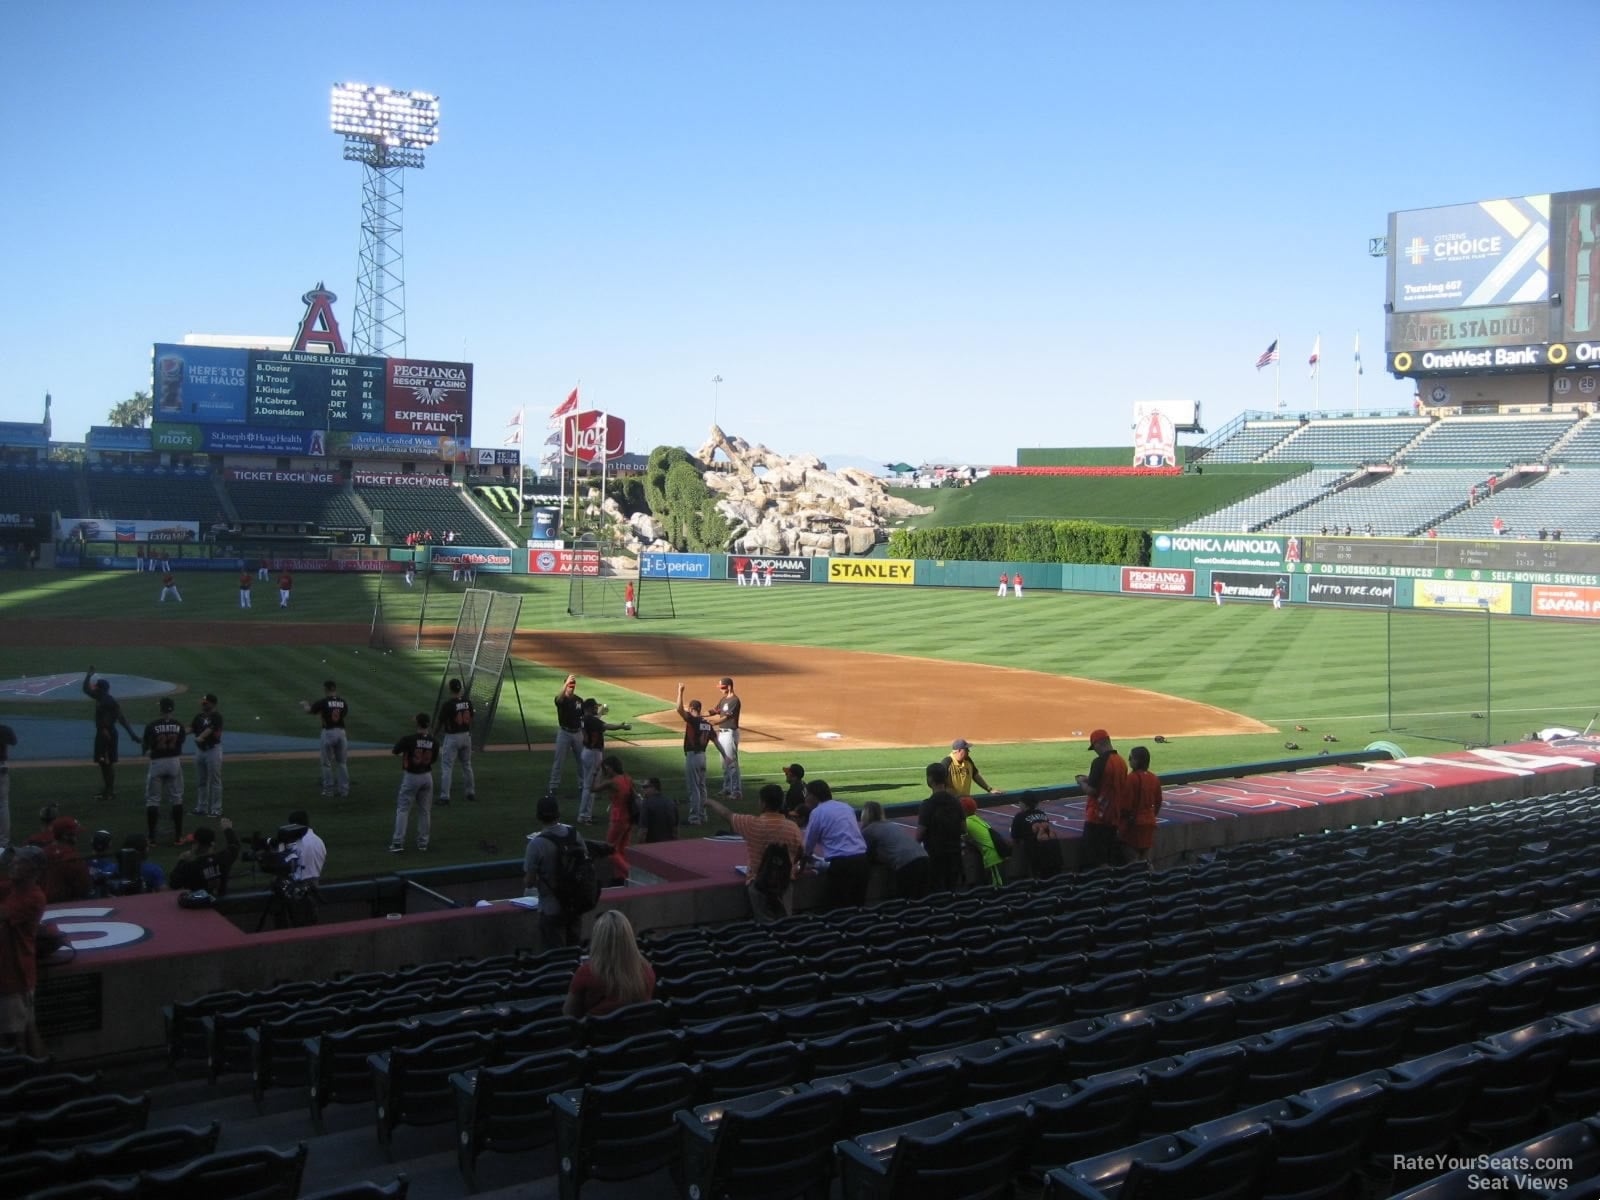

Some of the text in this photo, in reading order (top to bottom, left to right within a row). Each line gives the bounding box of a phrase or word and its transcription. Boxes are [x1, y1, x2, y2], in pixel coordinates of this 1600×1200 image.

[1434, 237, 1501, 257] CHOICE
[1404, 283, 1443, 294] Turning
[1405, 316, 1534, 341] ANGEL STADIUM
[295, 354, 317, 362] RUNS
[320, 356, 356, 365] LEADERS
[1423, 349, 1537, 368] OneWest Bank
[189, 366, 245, 377] HERE'S TO
[257, 364, 291, 372] B.Dozier
[394, 365, 466, 379] PECHANGA
[190, 376, 245, 386] THE HALOS
[256, 375, 288, 383] M.Trout
[393, 378, 426, 386] RESORT
[256, 386, 290, 394] I.Kinsler
[256, 397, 296, 405] M.Cabrera
[254, 408, 304, 416] J.Donaldson
[412, 422, 445, 431] IT ALL
[160, 435, 192, 445] more
[276, 434, 302, 443] Health
[386, 437, 413, 445] Crafted
[415, 438, 432, 446] With
[409, 447, 438, 455] Oranges
[234, 471, 272, 480] TICKET
[356, 476, 393, 484] TICKET
[1172, 538, 1280, 554] KONICA MINOLTA
[487, 555, 510, 564] Subs
[1194, 557, 1280, 566] CountOnKonicaMinolta.com
[656, 560, 703, 573] Experian
[832, 563, 911, 579] STANLEY
[1336, 565, 1387, 576] HOUSEHOLD
[1390, 568, 1433, 577] SERVICES
[1130, 571, 1186, 582] PECHANGA
[1492, 572, 1597, 585] SELF-MOVING SERVICES
[1213, 582, 1273, 597] hermador
[1311, 583, 1392, 598] NITTO TIRE.COM
[1537, 599, 1590, 611] SAFARI
